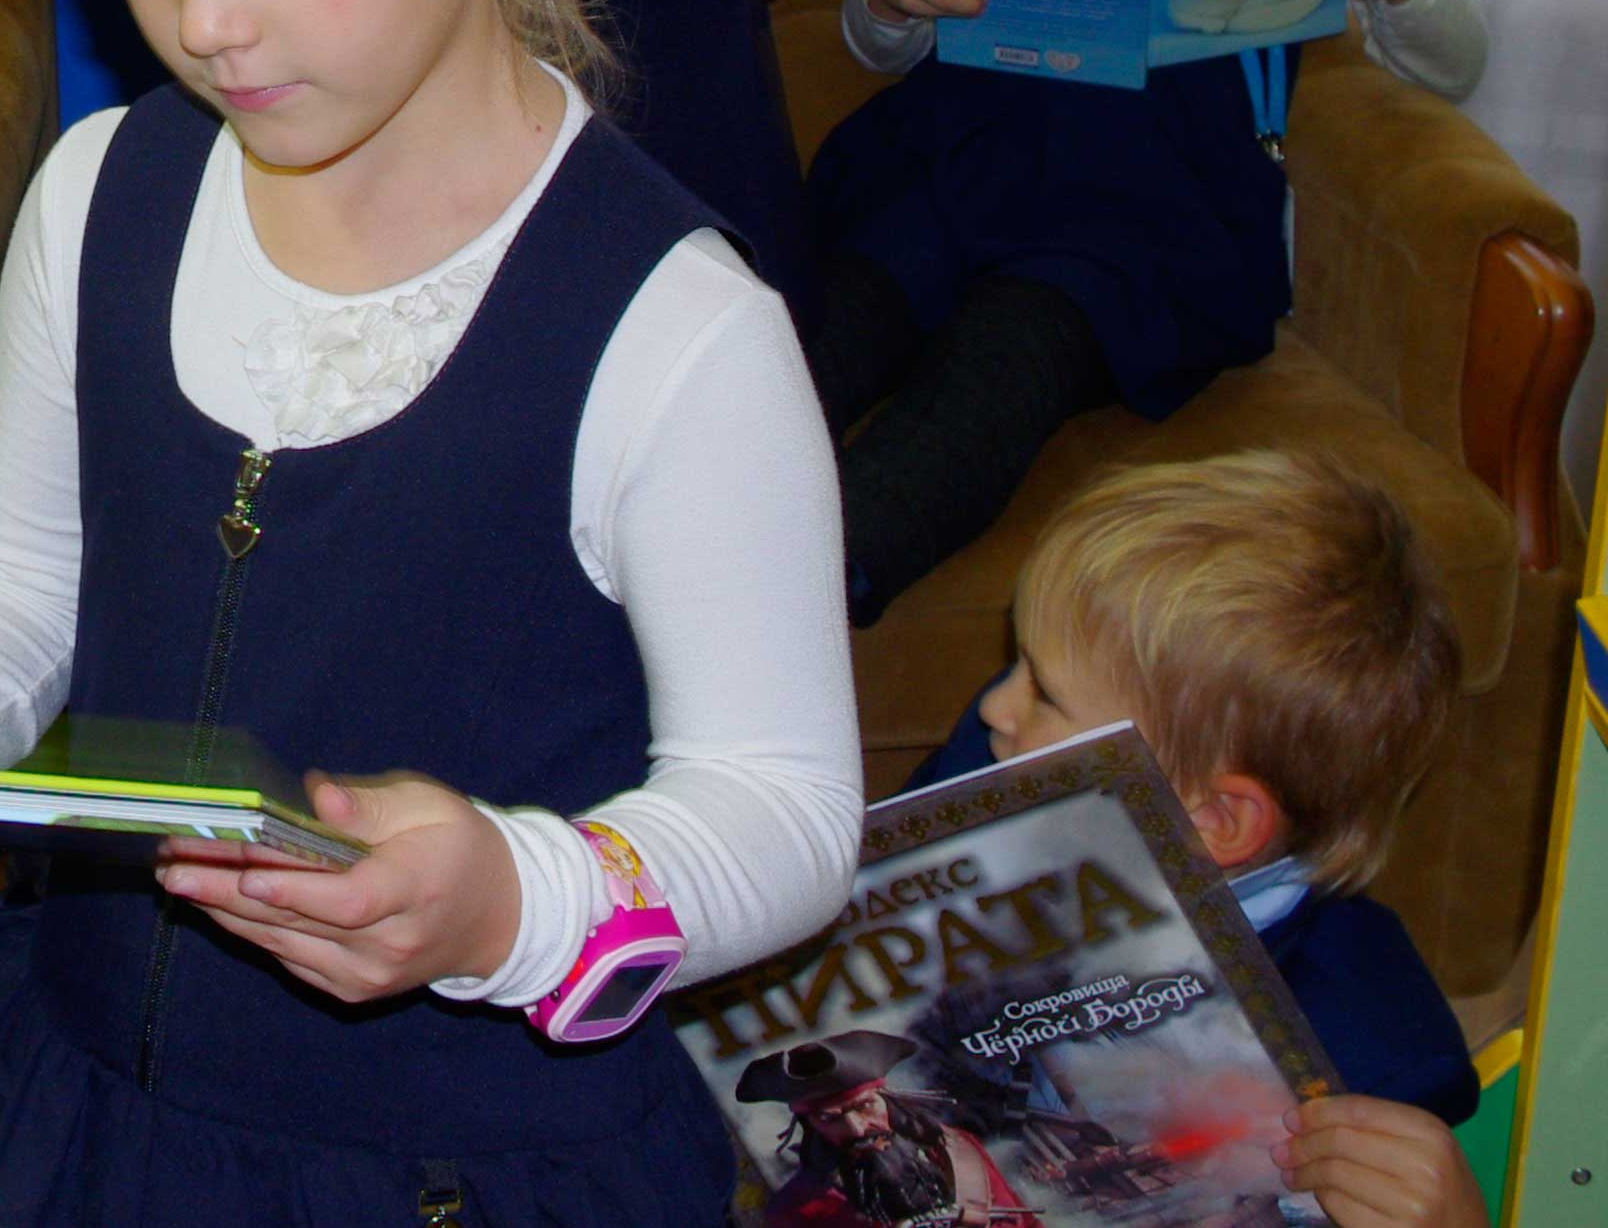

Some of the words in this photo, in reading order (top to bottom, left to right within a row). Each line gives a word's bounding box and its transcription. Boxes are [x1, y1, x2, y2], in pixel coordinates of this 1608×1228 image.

[692, 859, 1164, 1058] ПИРАТА
[1004, 974, 1130, 1020] Сокровища
[960, 1015, 1082, 1066] Чёрной
[1083, 974, 1205, 1032] Бороды
